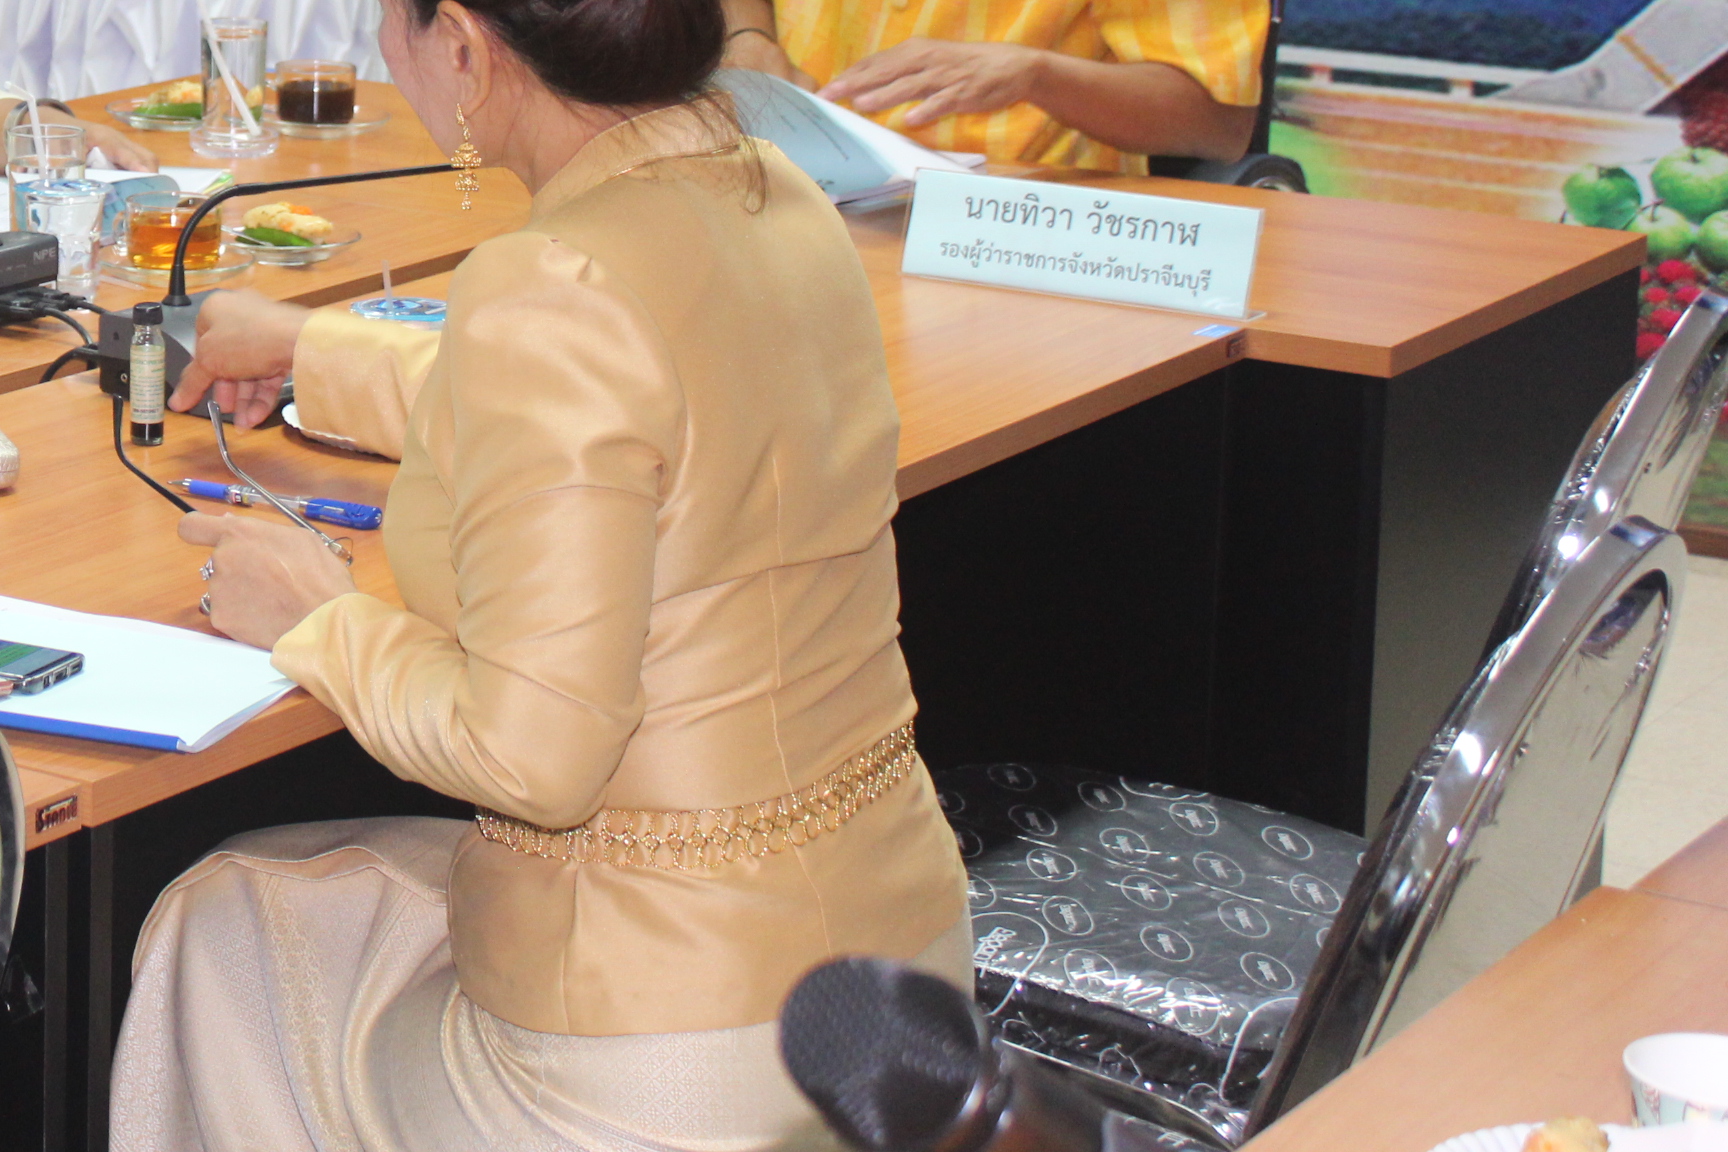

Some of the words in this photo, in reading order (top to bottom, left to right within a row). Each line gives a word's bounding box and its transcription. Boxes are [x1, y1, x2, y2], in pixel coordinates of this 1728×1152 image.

[965, 193, 1073, 231] นายทิวา
[1087, 201, 1201, 247] วัชรกาฬ
[939, 239, 1212, 296] รองผู้ว่าราชการจังหวัดปราจีนบุรี
